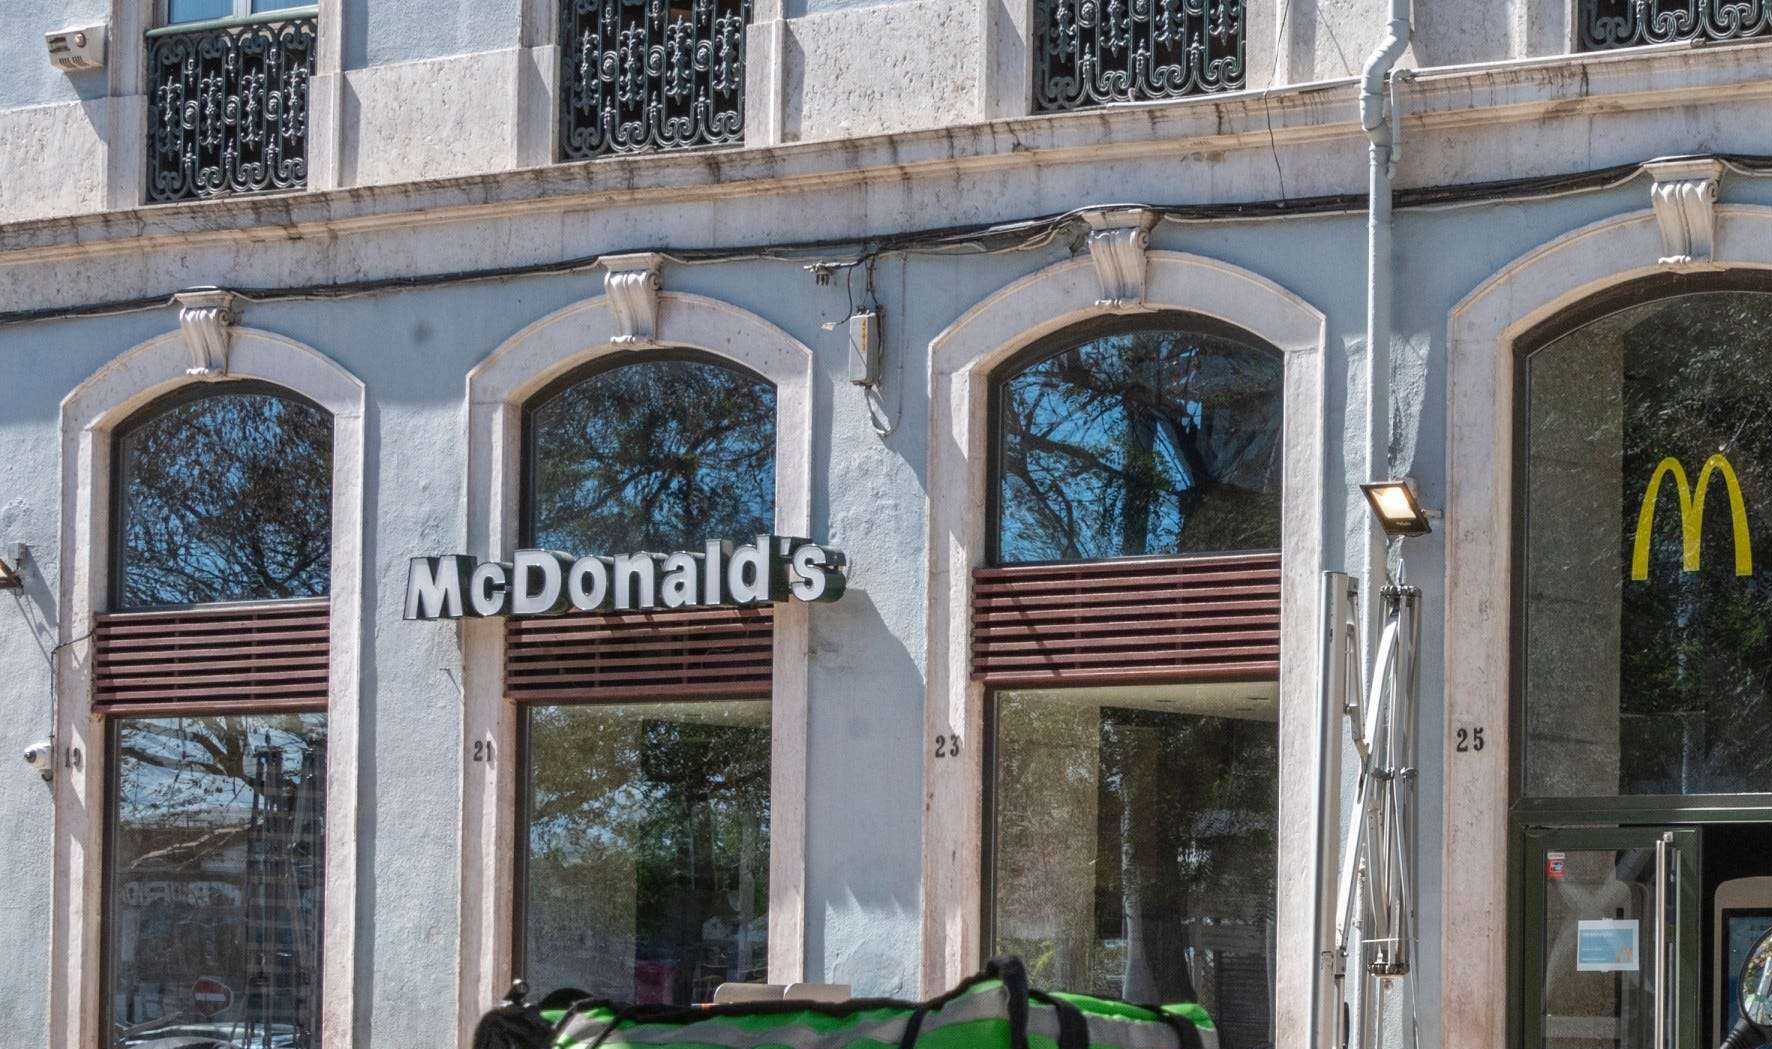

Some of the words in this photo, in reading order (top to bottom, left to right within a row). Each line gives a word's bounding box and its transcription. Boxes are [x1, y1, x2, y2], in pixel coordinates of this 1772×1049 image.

[403, 534, 838, 620] McDonald's
[473, 740, 492, 762] 21
[935, 734, 960, 758] 23
[1456, 727, 1485, 752] 25
